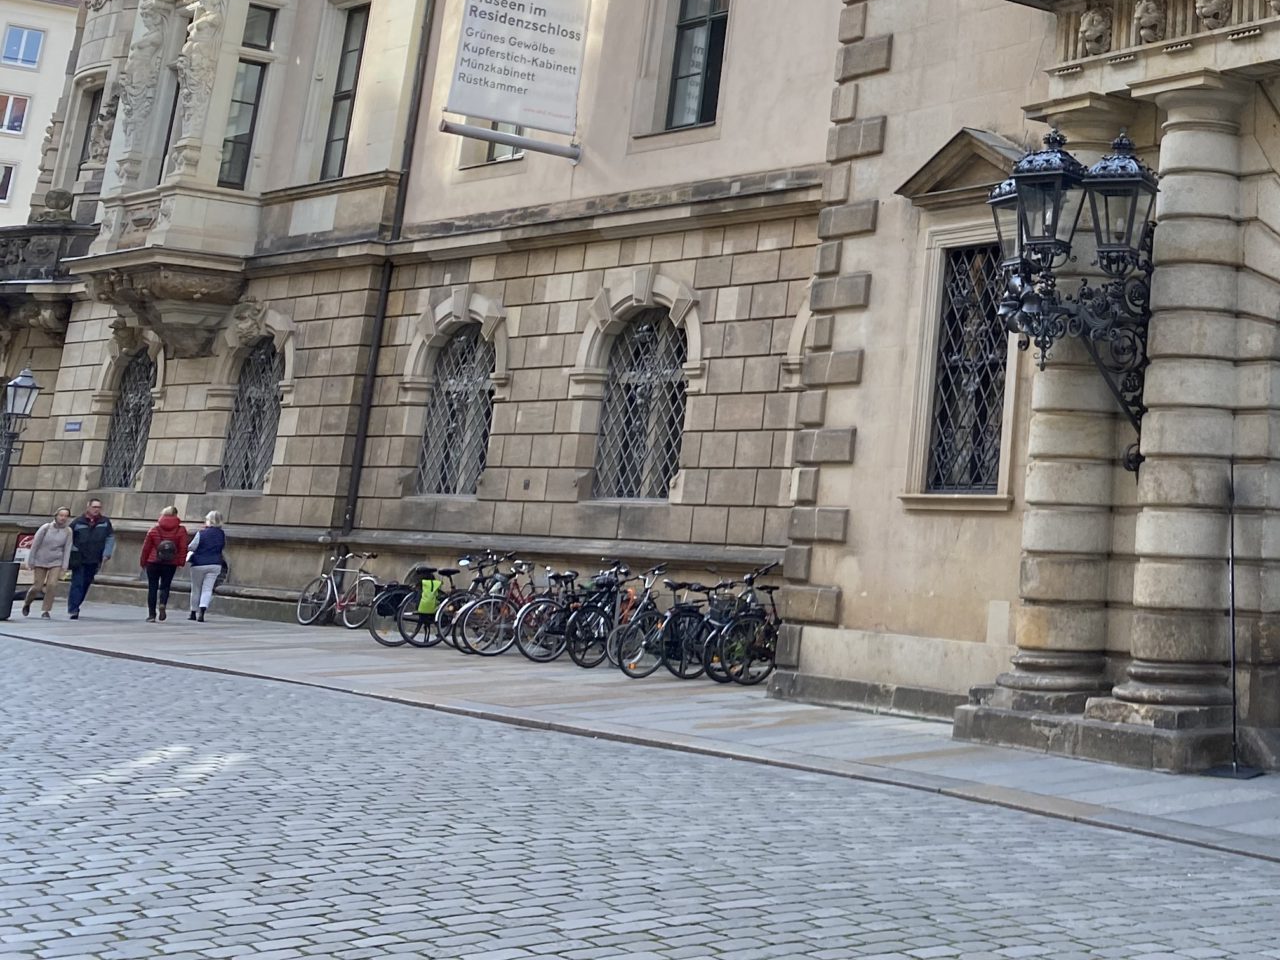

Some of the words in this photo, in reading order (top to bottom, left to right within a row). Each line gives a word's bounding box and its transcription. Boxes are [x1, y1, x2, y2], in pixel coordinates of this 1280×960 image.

[529, 3, 547, 17] im
[469, 5, 582, 42] Residenzschloss
[465, 27, 506, 44] Grünes
[508, 36, 556, 55] Gewölbe
[460, 57, 537, 82] Münzkabinett
[462, 42, 577, 75] Kupferstich-Kabinett
[458, 72, 529, 95] Rüstkammer
